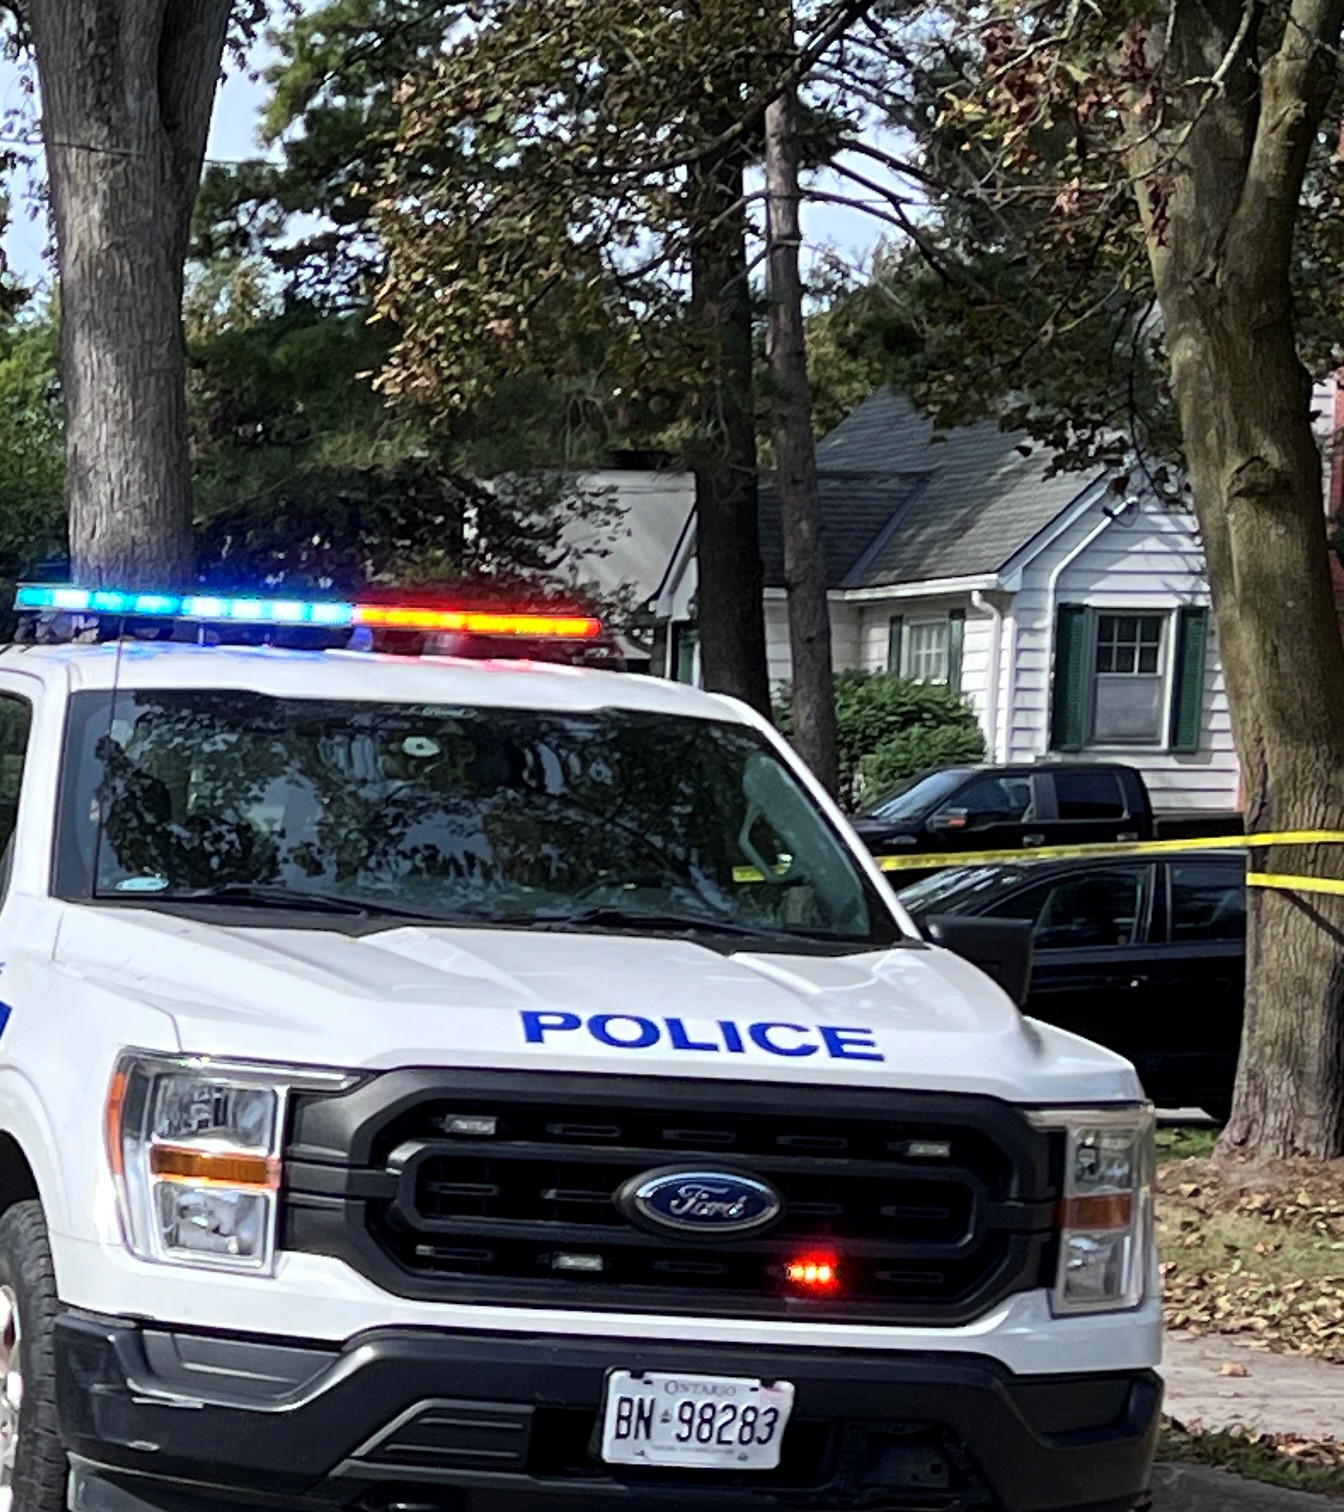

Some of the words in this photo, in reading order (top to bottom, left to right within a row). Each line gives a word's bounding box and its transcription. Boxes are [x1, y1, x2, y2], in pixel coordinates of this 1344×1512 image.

[519, 1009, 886, 1063] POLICE
[669, 1183, 748, 1219] Ford
[664, 1379, 737, 1397] ONTARIO
[615, 1395, 656, 1441] BN
[675, 1400, 780, 1446] 98283
